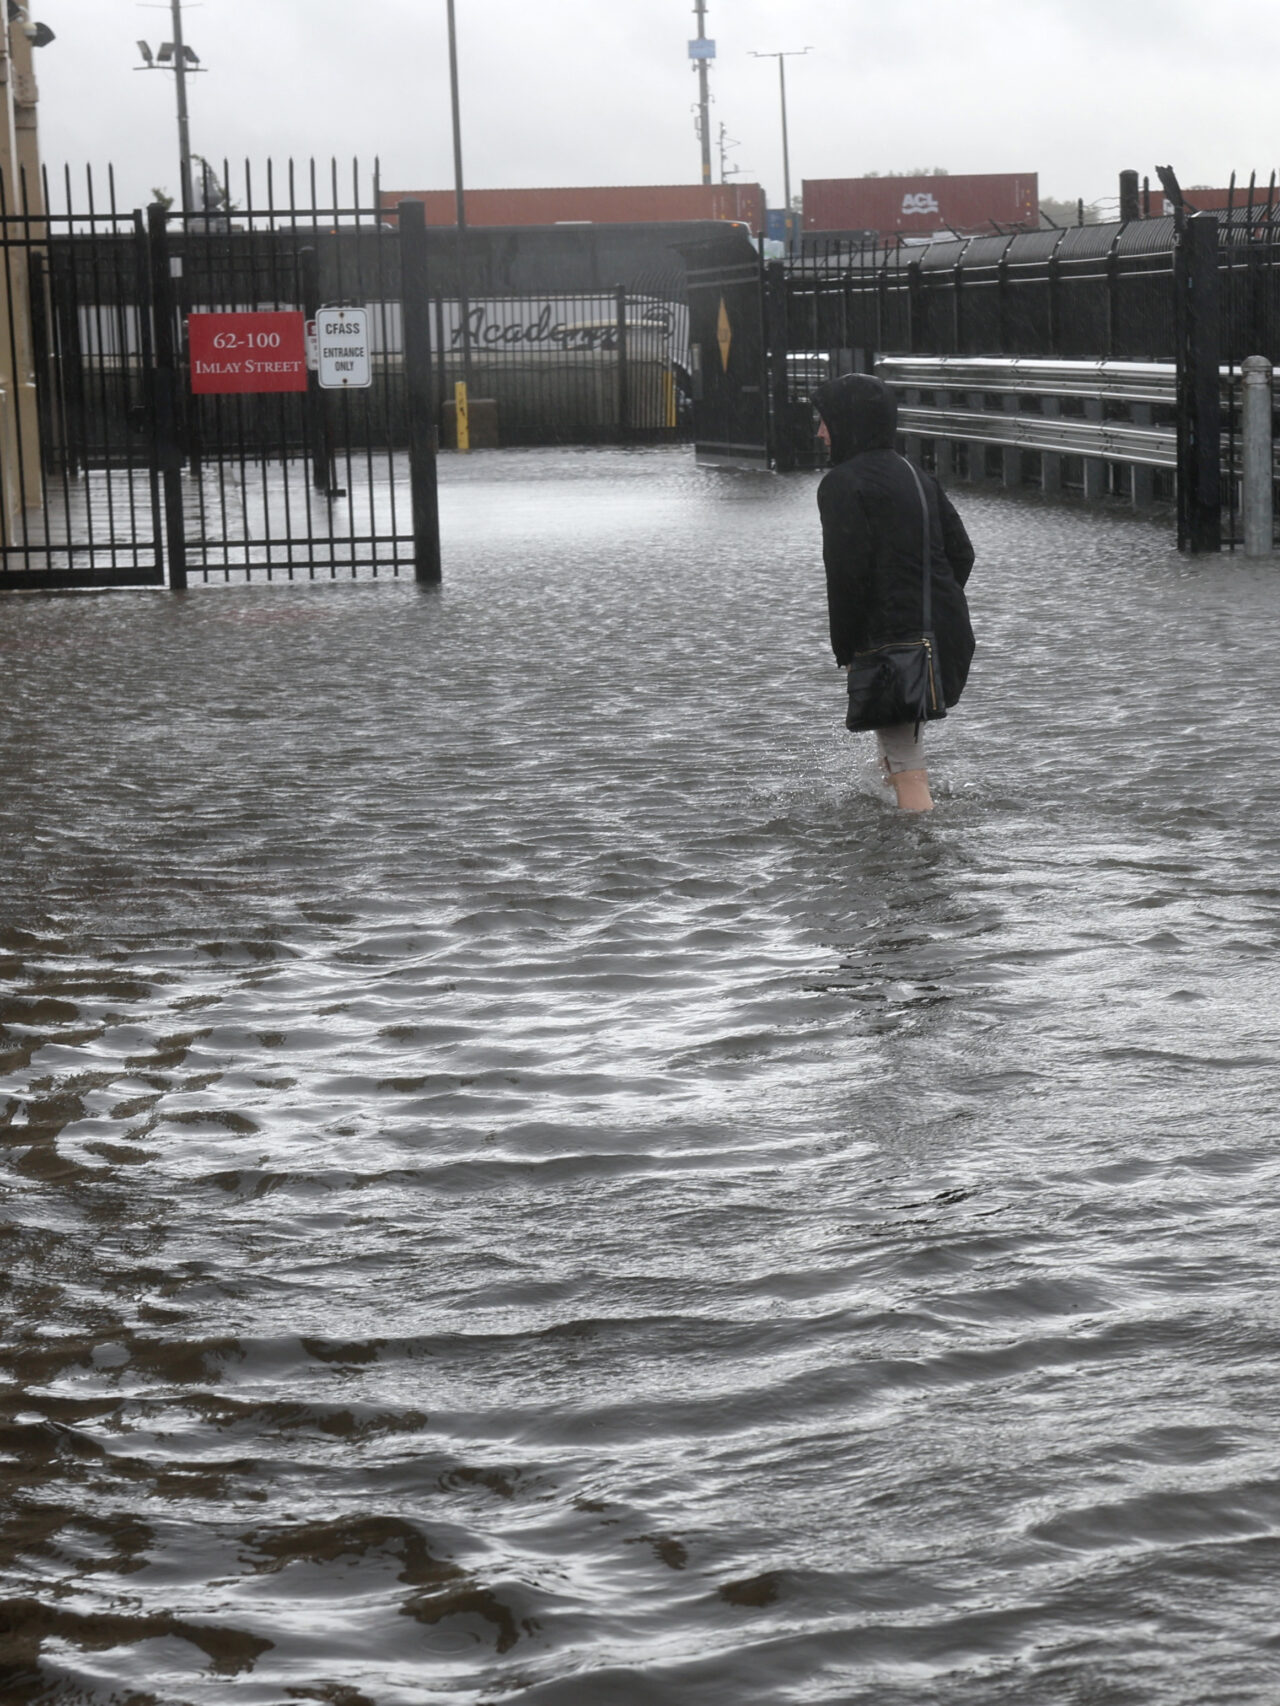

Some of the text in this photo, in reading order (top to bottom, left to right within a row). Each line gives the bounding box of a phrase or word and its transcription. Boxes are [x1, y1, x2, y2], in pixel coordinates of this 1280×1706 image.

[902, 193, 938, 207] ACL
[325, 323, 360, 335] CFASS
[213, 332, 281, 349] 62-100
[323, 347, 365, 358] ENTRANCE
[195, 359, 302, 374] IMLAY STREET
[334, 361, 354, 372] ONLY
